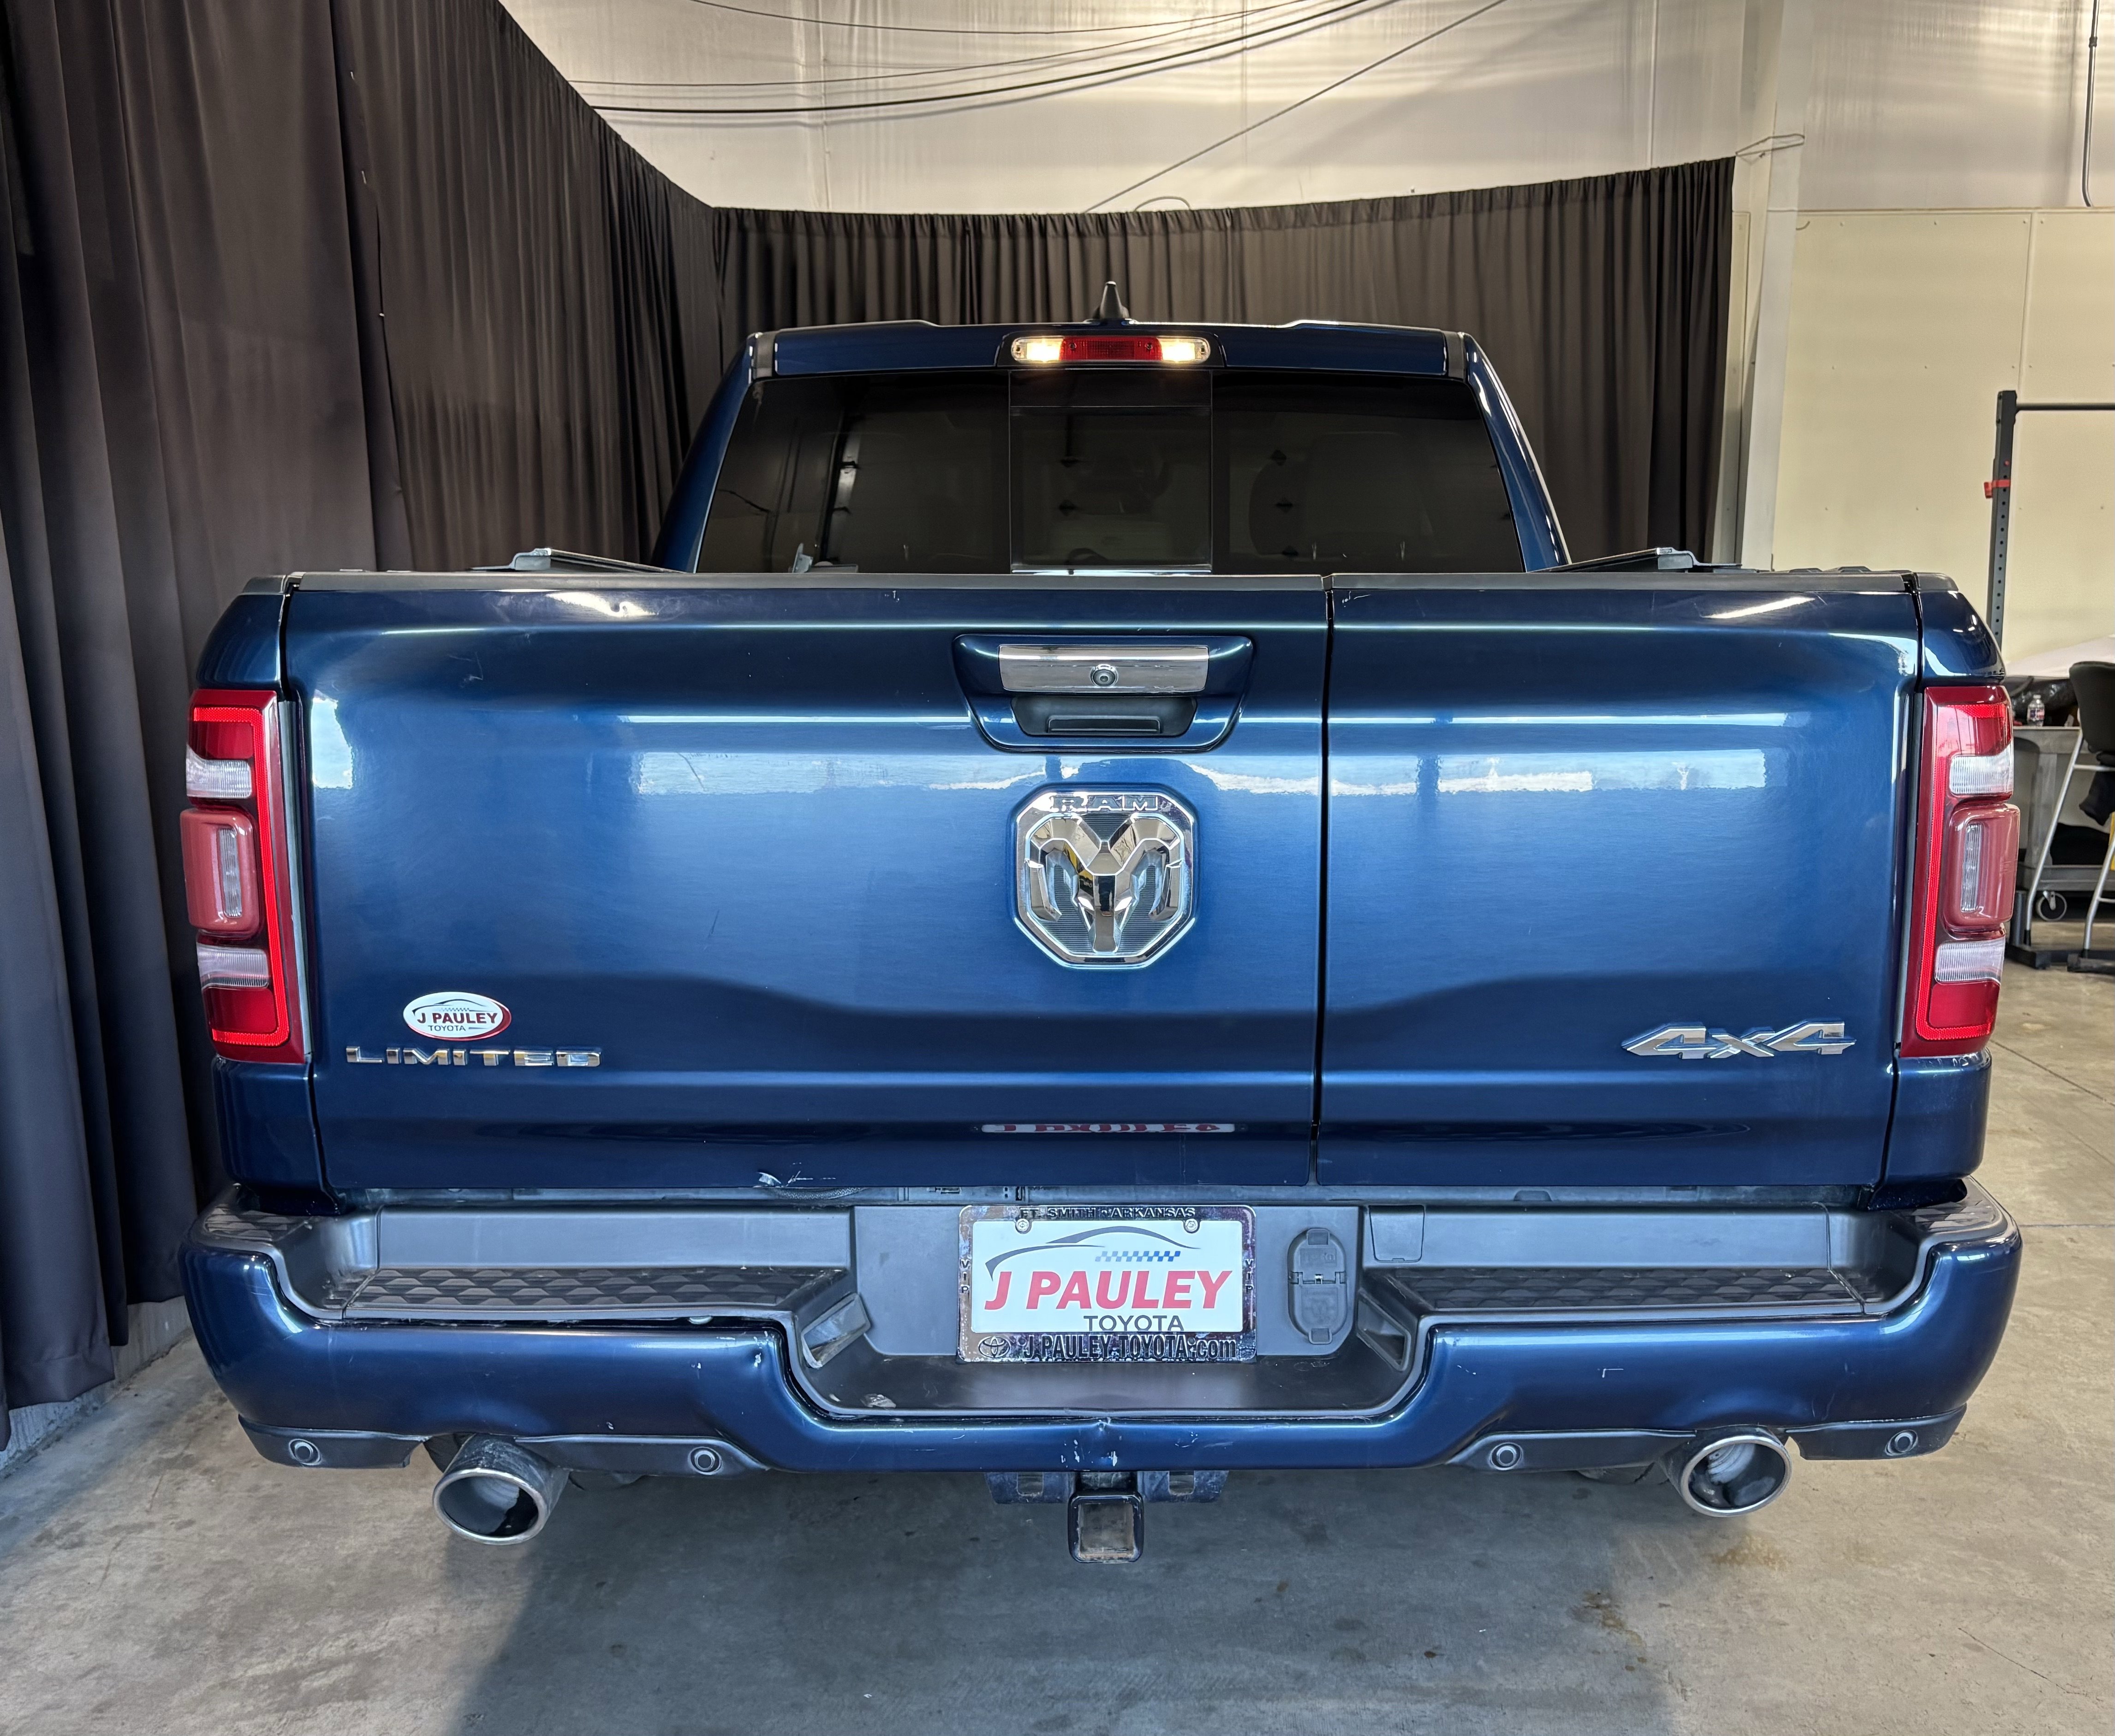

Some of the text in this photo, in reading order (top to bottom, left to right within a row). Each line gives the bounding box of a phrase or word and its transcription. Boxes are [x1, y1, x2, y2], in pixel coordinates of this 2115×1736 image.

[1054, 794, 1158, 811] RAM
[417, 1012, 498, 1024] J PAULEY
[346, 1046, 601, 1067] LIMITED
[1048, 1207, 1096, 1218] SMITH
[1110, 1207, 1196, 1218] ARKANSAS
[984, 1271, 1232, 1310] J PAULEY
[1084, 1315, 1184, 1331] TOYOTA
[1041, 1334, 1113, 1359] PAULEY
